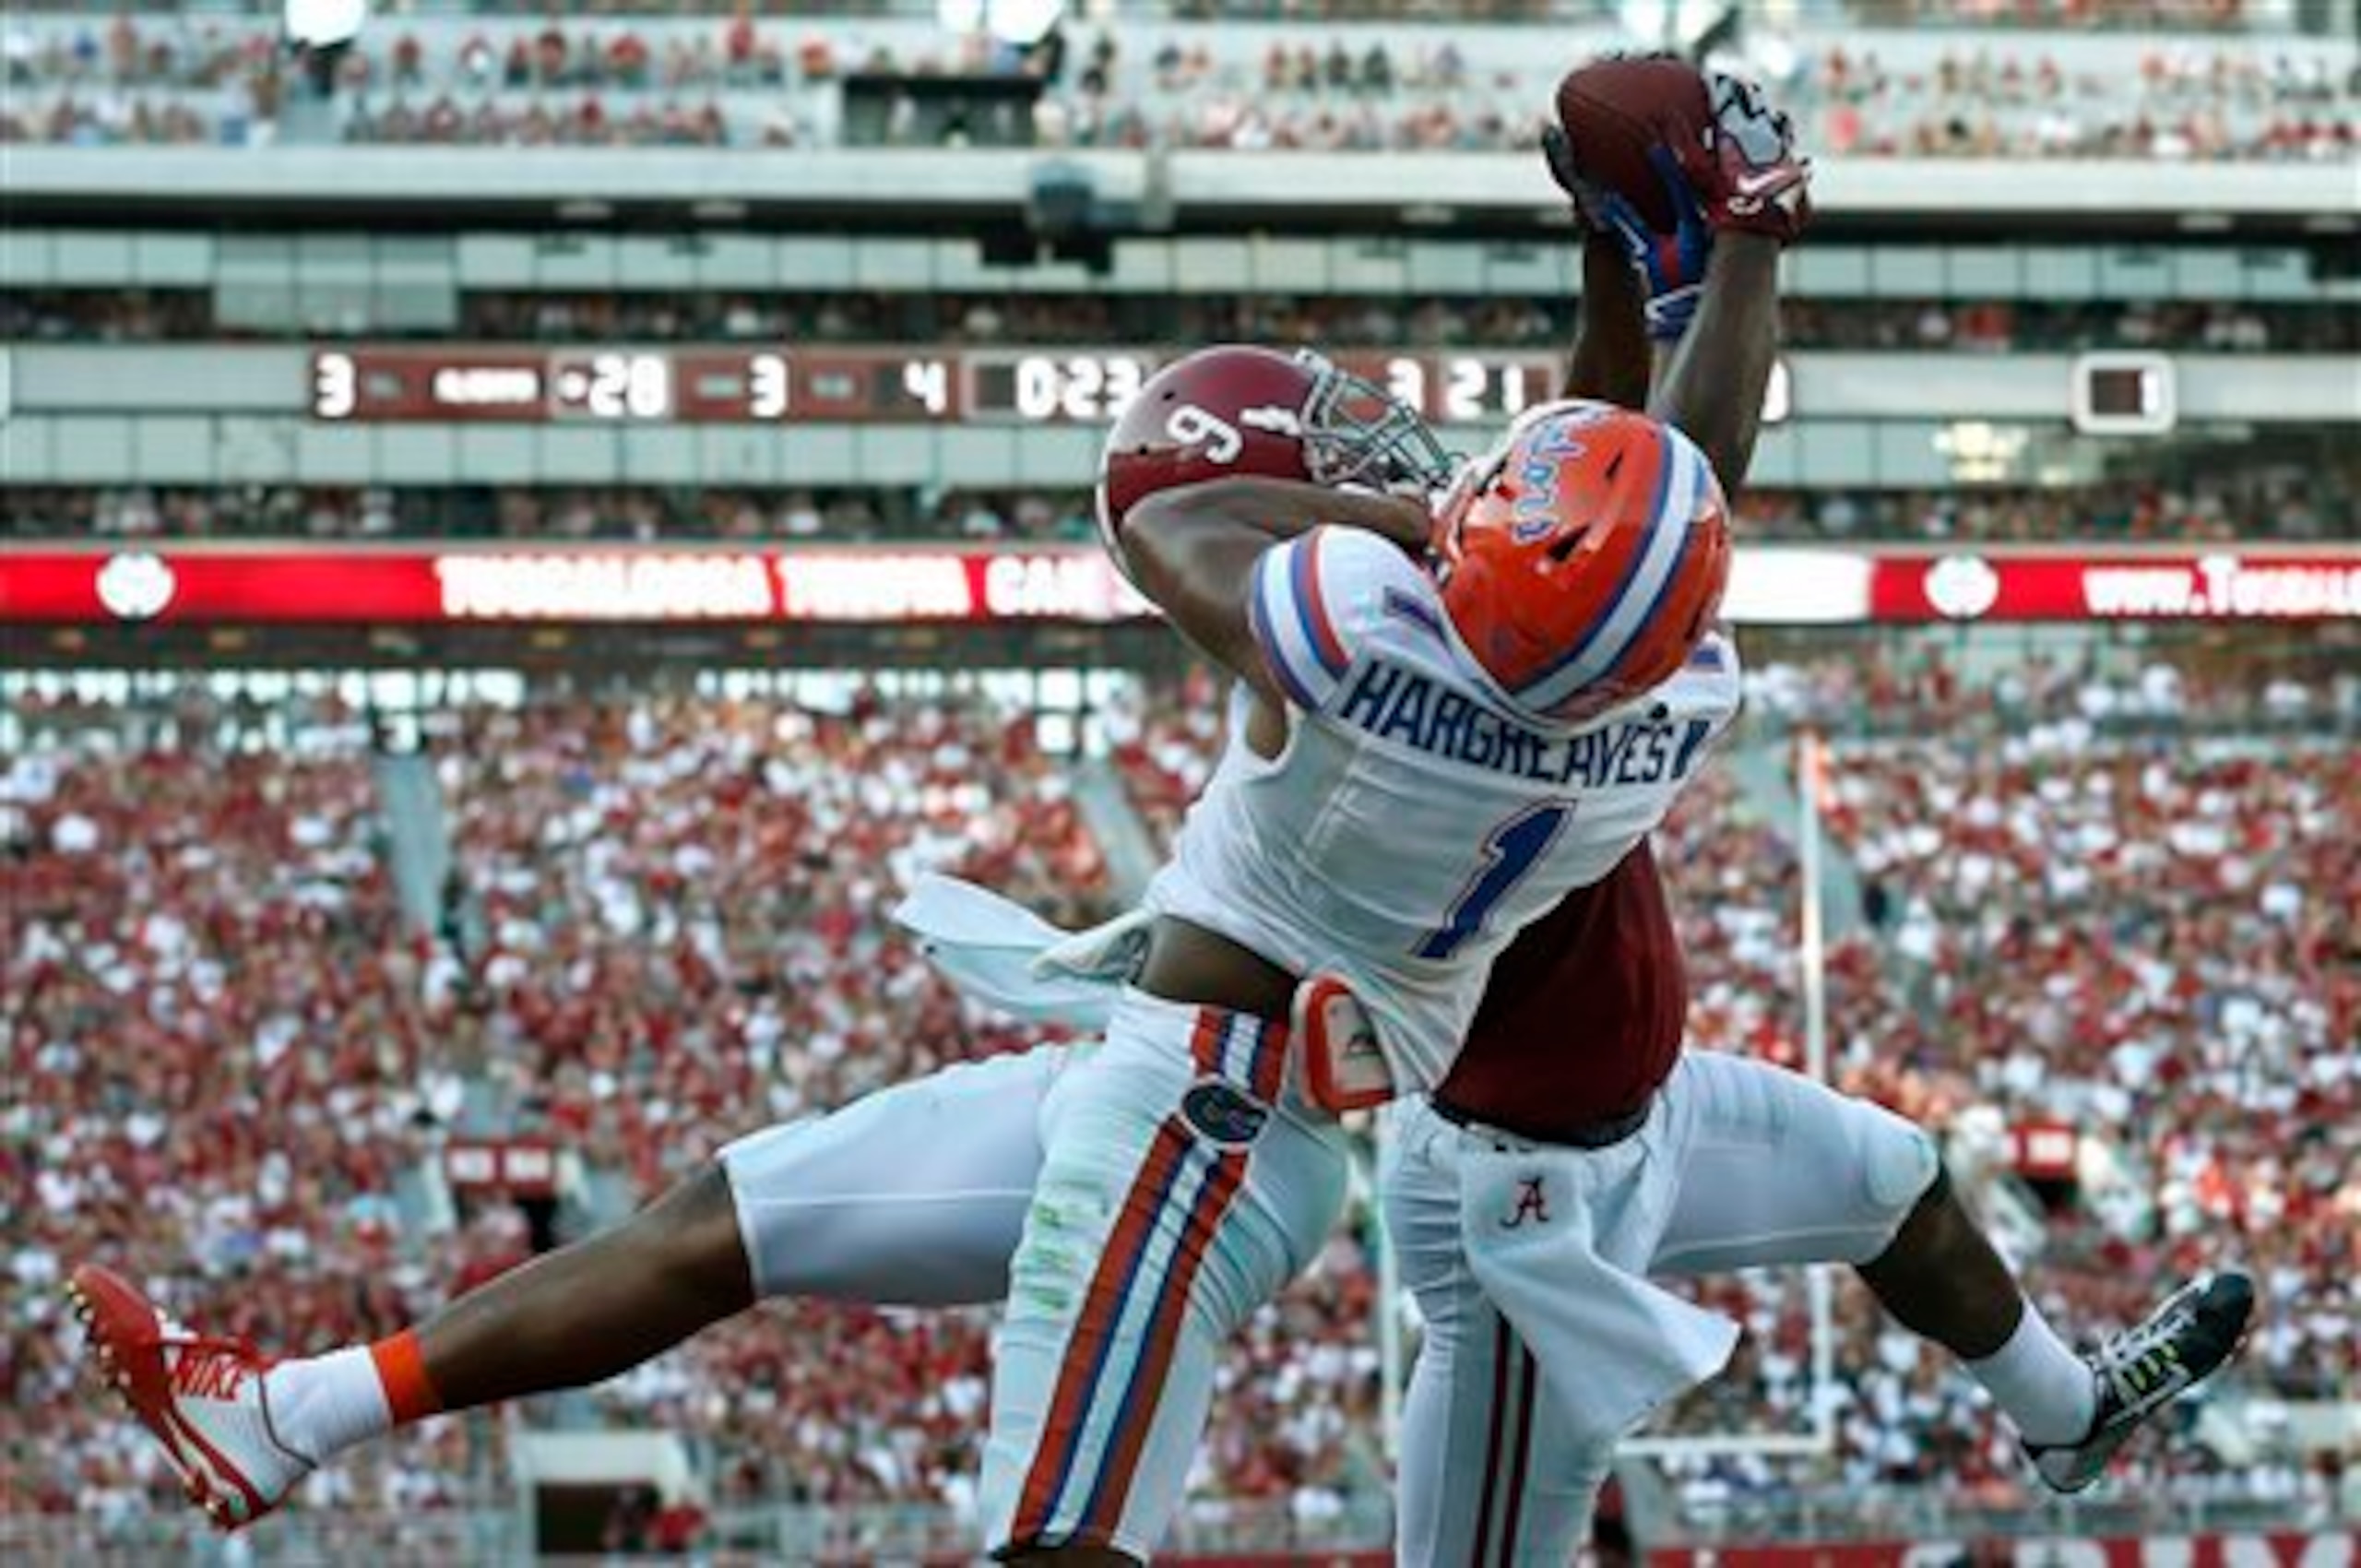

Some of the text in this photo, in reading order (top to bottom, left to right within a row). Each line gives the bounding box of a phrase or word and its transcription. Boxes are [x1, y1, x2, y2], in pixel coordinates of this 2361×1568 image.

[314, 353, 356, 417] 3
[750, 353, 789, 417] 3
[902, 362, 946, 413] 4
[1166, 403, 1243, 465] 9
[1404, 793, 1579, 961] 1
[1500, 1175, 1549, 1229] A
